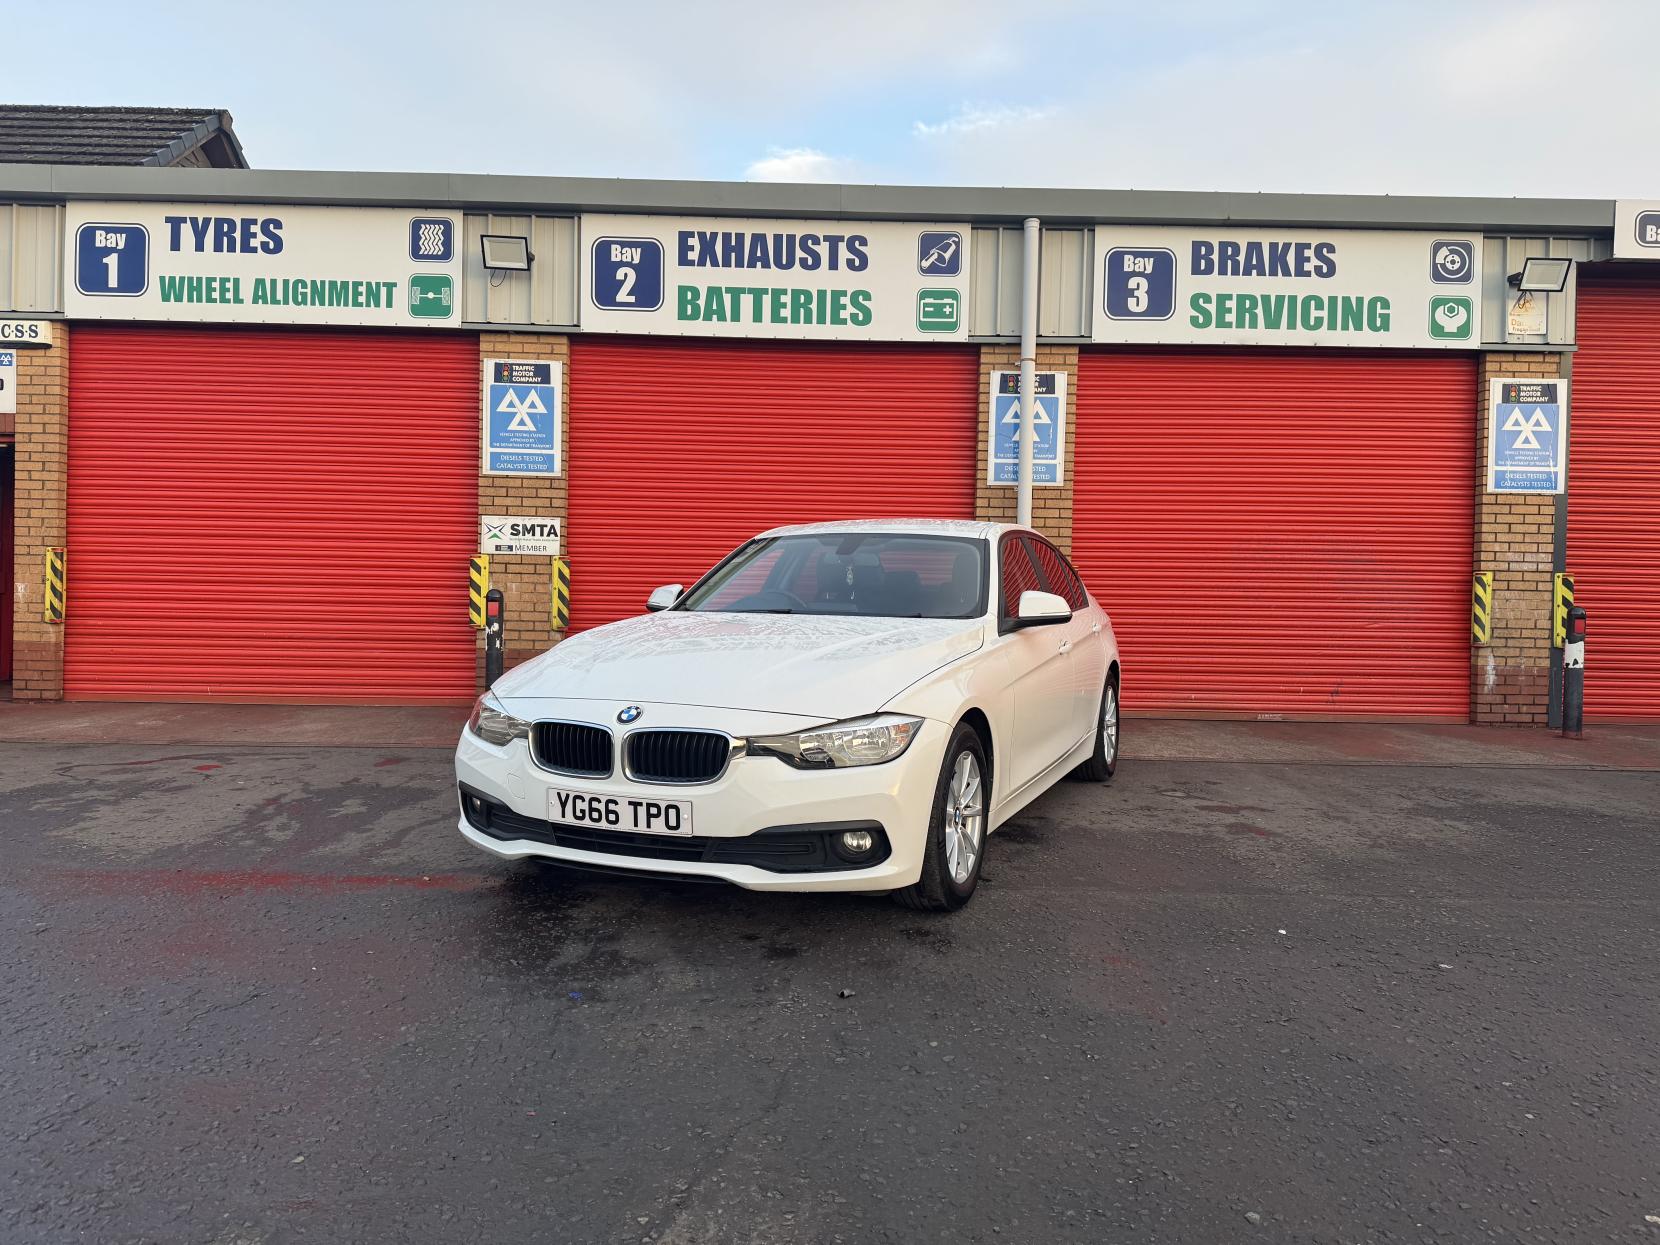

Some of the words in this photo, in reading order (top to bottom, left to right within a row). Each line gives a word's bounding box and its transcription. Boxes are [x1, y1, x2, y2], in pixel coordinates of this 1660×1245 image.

[95, 230, 126, 250] Bay
[165, 216, 284, 255] TYRES
[678, 230, 869, 272] EXHAUSTS
[1646, 225, 1660, 242] Ba
[102, 252, 119, 288] 1
[610, 244, 641, 265] Bay
[1123, 254, 1154, 274] Bay
[1191, 240, 1337, 279] BRAKES
[159, 275, 245, 305] WHEEL
[252, 277, 398, 309] ALIGNMENT
[615, 266, 636, 303] 2
[1127, 276, 1149, 313] 3
[677, 284, 873, 327] BATTERIES
[1189, 292, 1391, 333] SERVICING
[509, 523, 559, 538] SMTA
[557, 791, 620, 825] YG66
[628, 801, 680, 831] TPO
